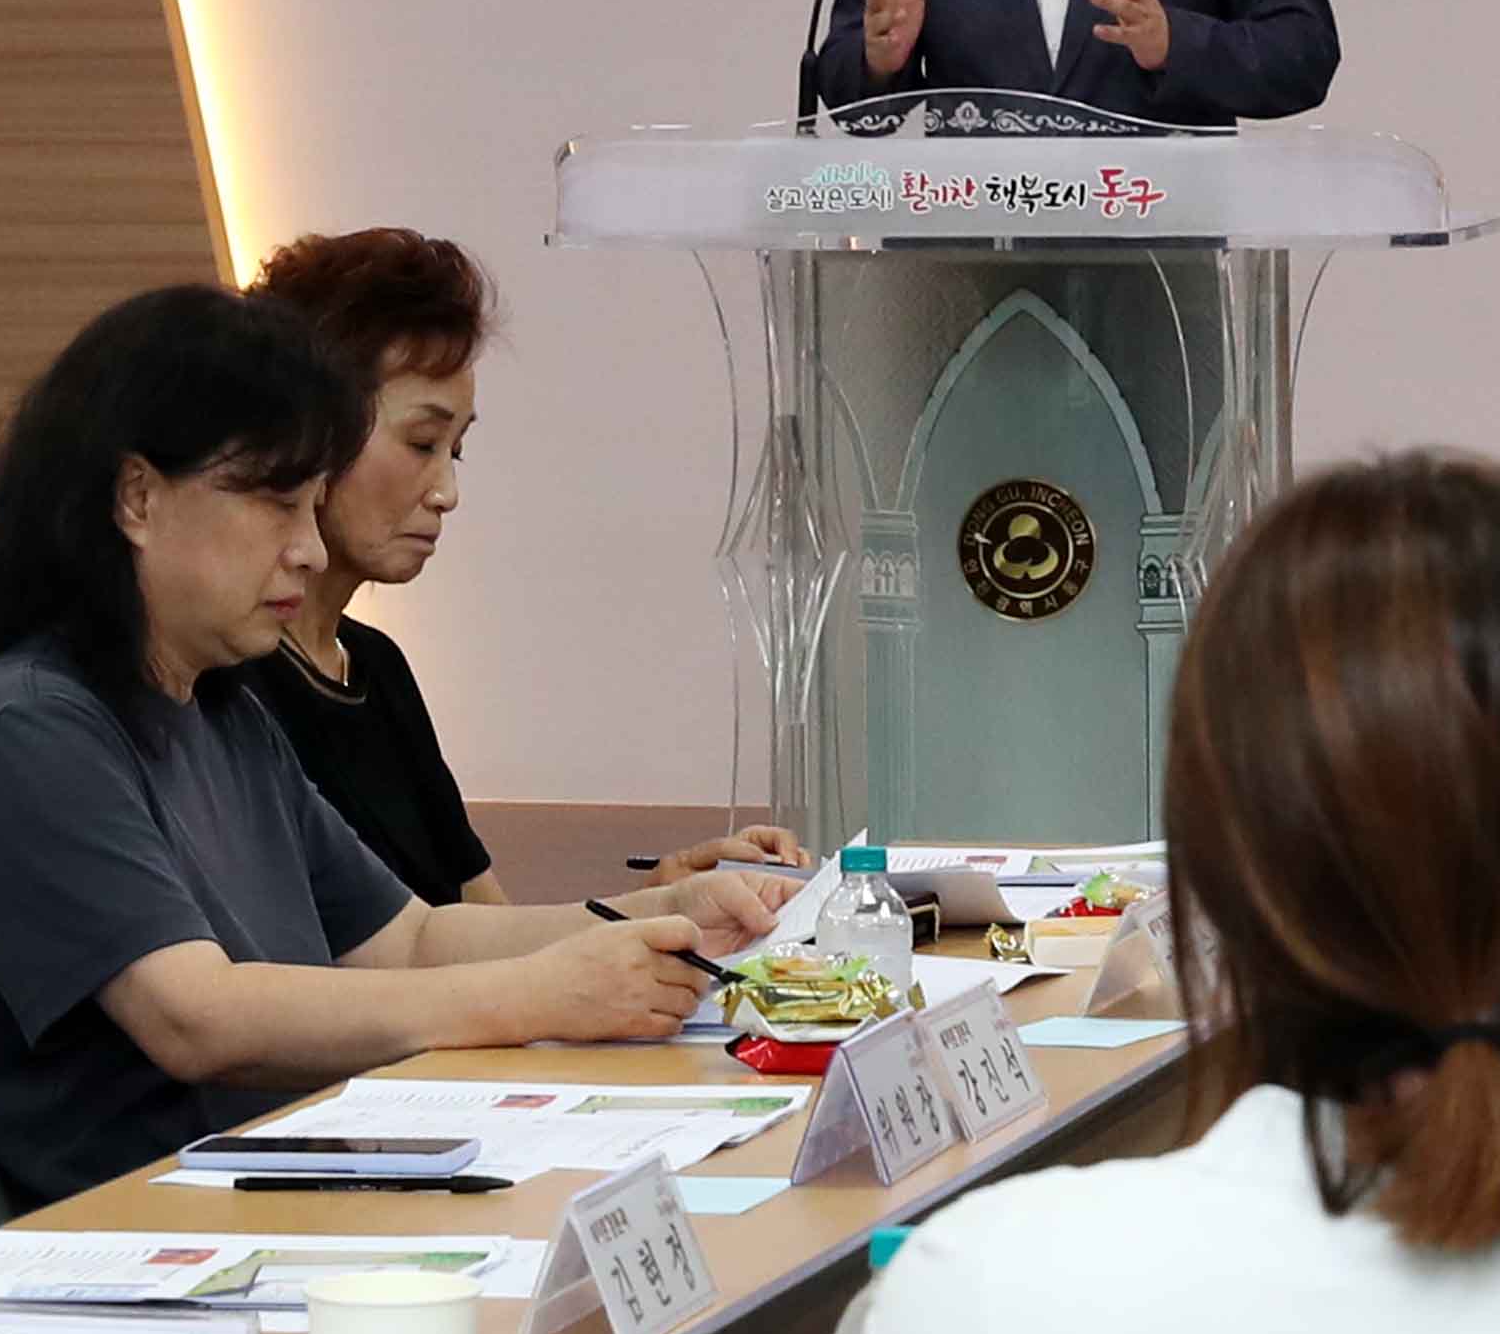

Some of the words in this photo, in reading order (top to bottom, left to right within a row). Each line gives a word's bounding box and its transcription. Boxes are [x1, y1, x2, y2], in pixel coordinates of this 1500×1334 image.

[807, 186, 844, 211] 싶은
[900, 170, 976, 213] 활기찬
[984, 174, 1087, 215] 행복도시
[1092, 168, 1165, 216] 동구
